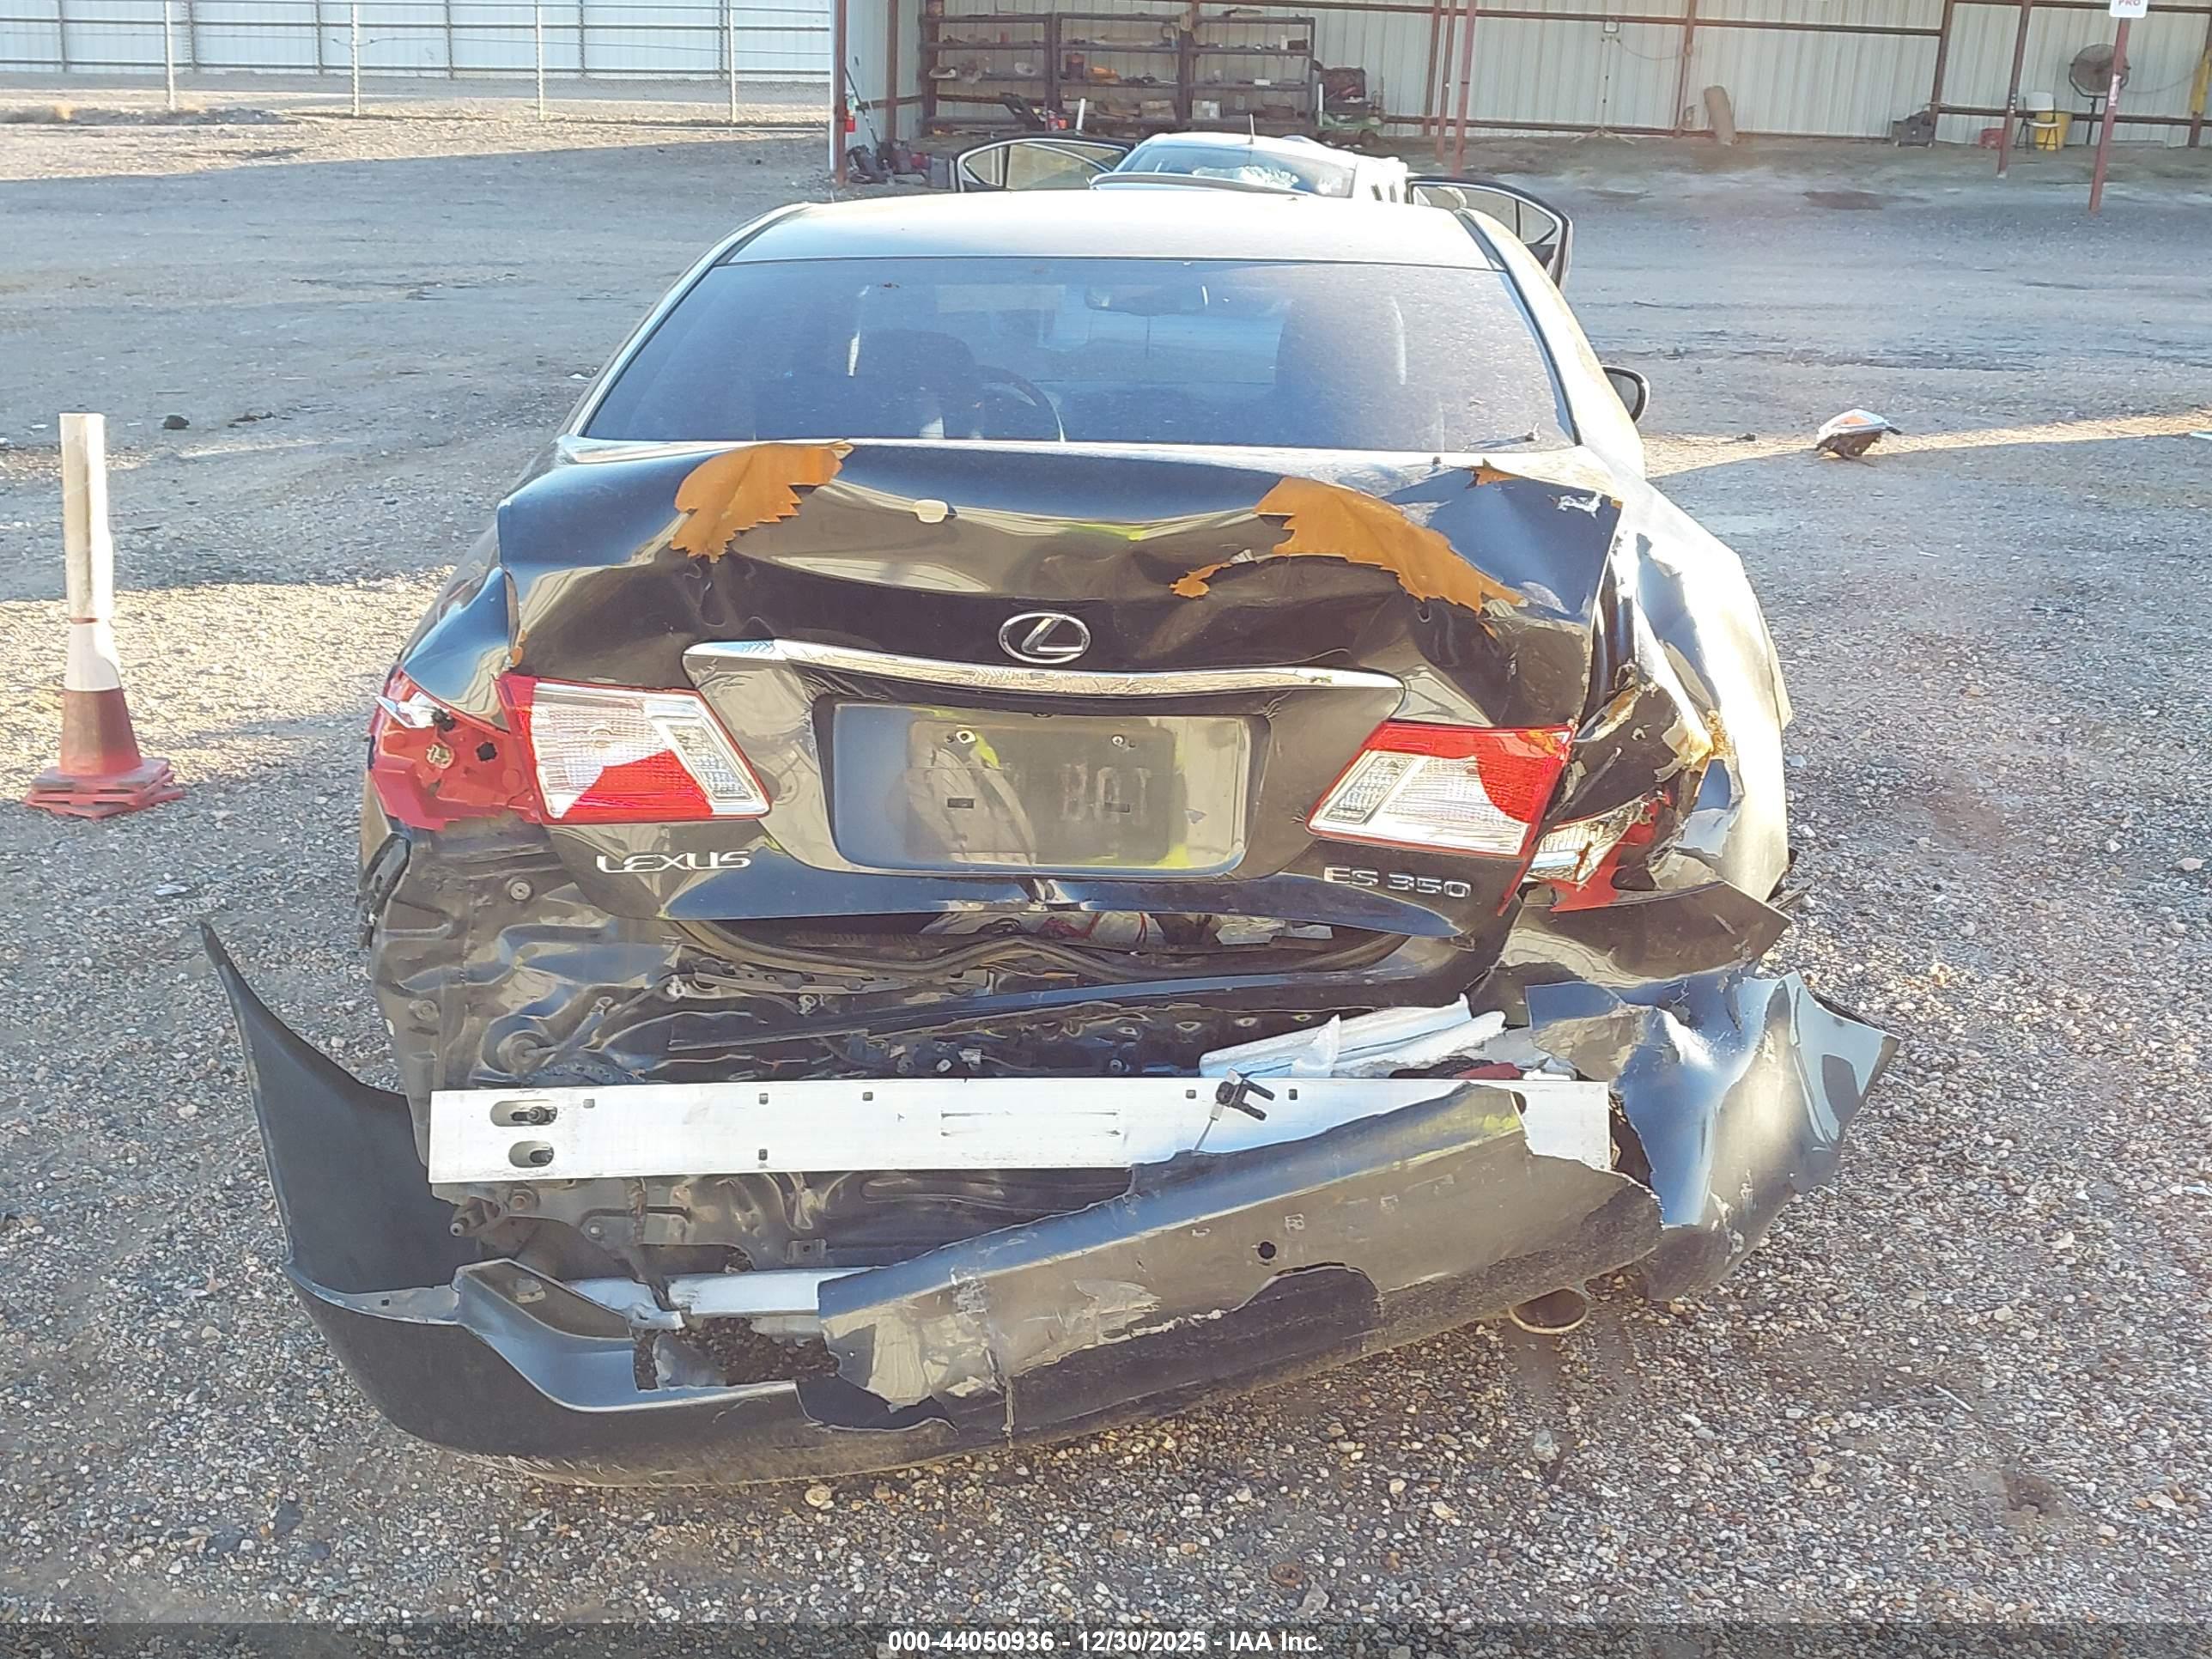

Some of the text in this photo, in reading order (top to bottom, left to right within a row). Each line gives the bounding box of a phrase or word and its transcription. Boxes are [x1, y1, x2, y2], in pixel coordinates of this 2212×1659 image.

[595, 851, 751, 873] LEXUS
[1323, 864, 1474, 900] ES 350
